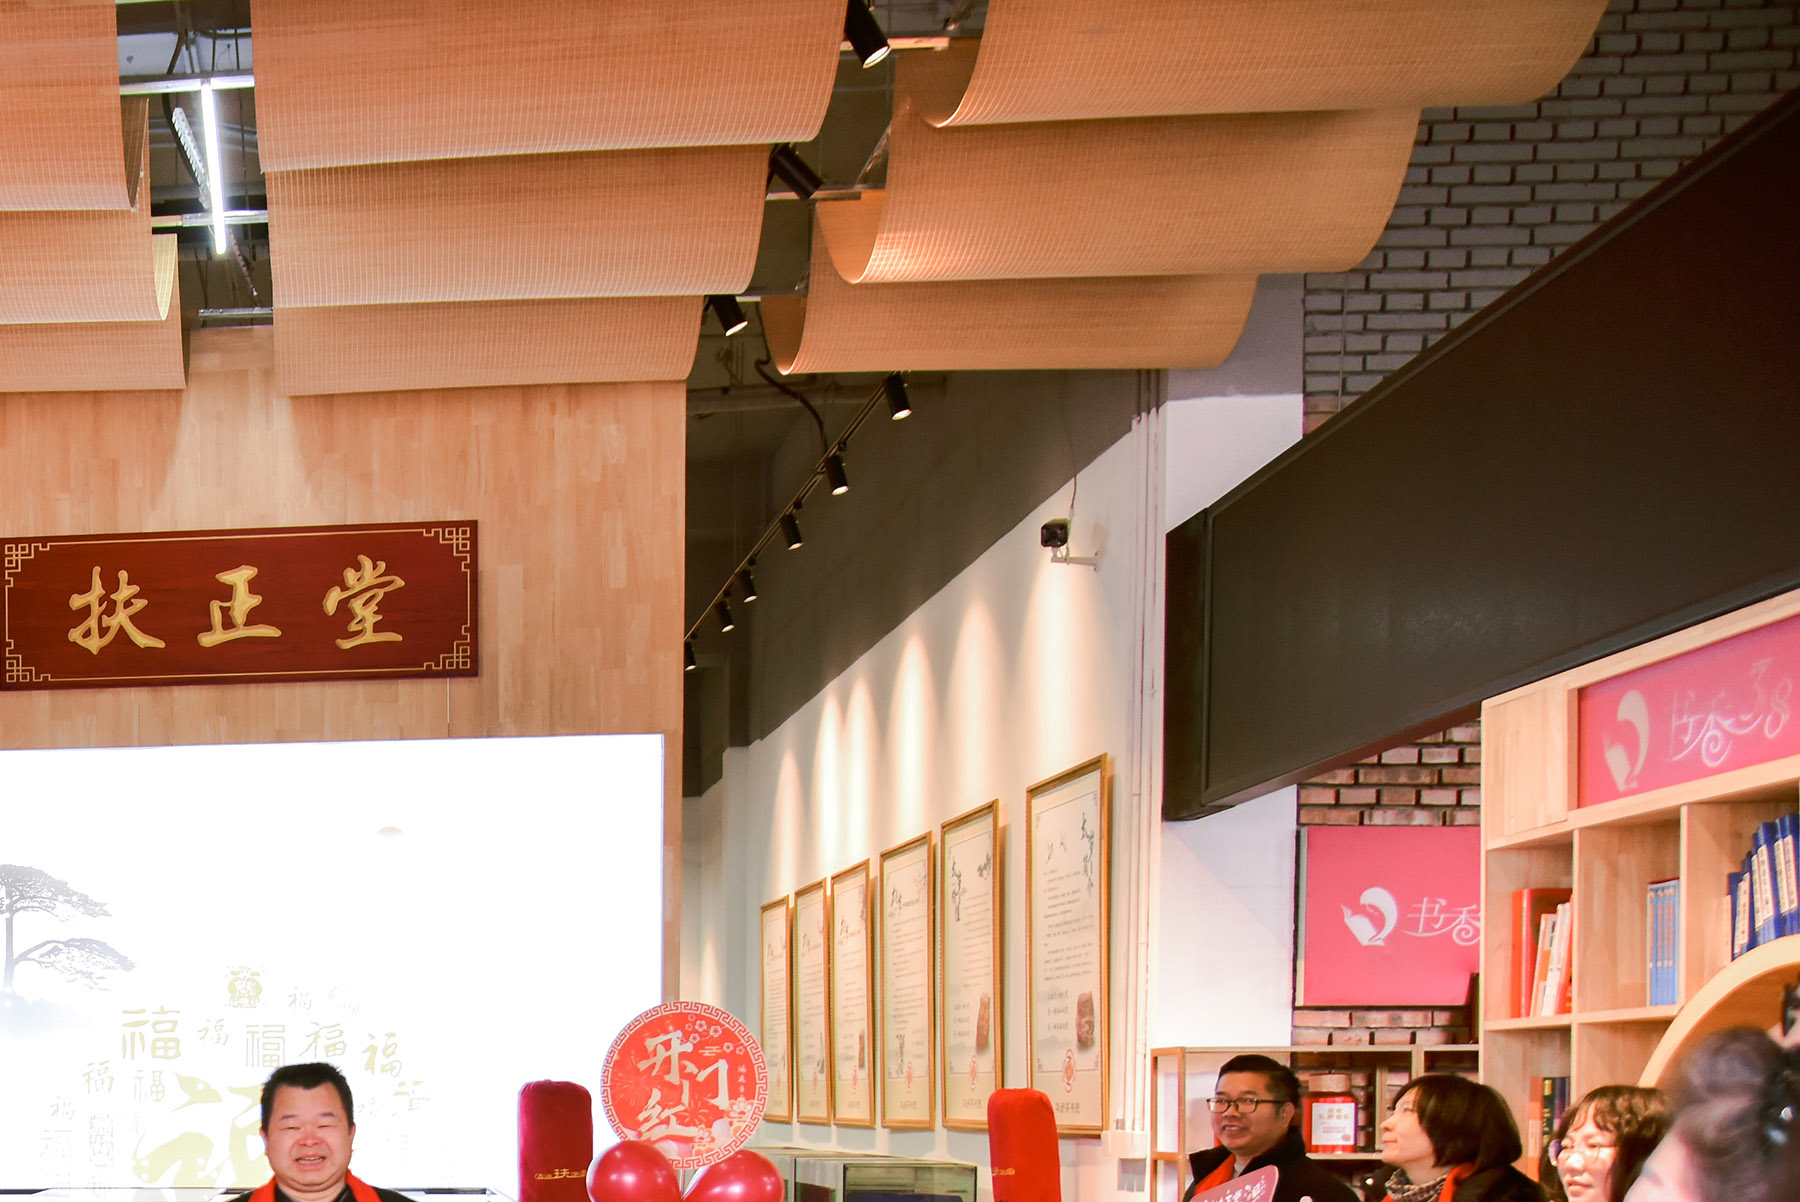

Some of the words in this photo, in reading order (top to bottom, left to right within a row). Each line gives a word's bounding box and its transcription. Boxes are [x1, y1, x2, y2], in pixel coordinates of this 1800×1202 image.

[68, 554, 405, 654] 扶正堂
[121, 1005, 181, 1060] 福
[637, 1030, 729, 1140] 开门红
